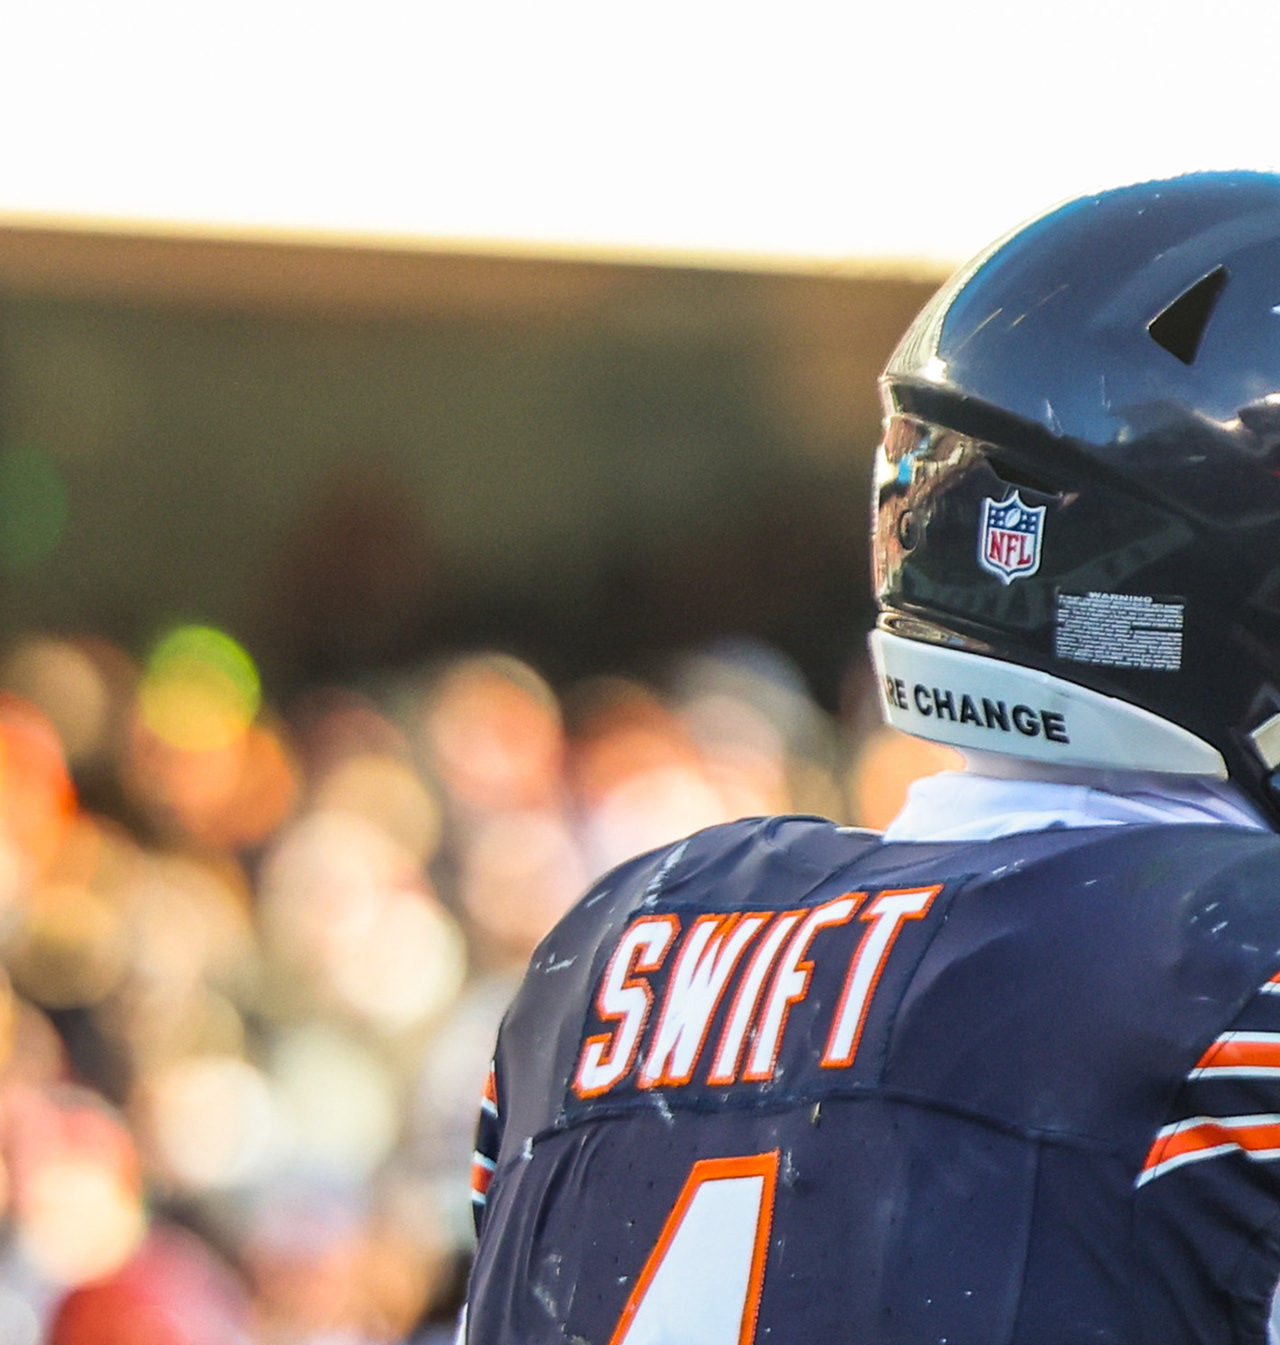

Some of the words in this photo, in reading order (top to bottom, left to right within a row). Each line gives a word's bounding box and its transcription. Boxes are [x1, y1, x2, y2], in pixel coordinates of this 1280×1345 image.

[988, 530, 1032, 568] NFL
[914, 683, 1070, 744] CHANGE
[571, 883, 945, 1099] SWIFT
